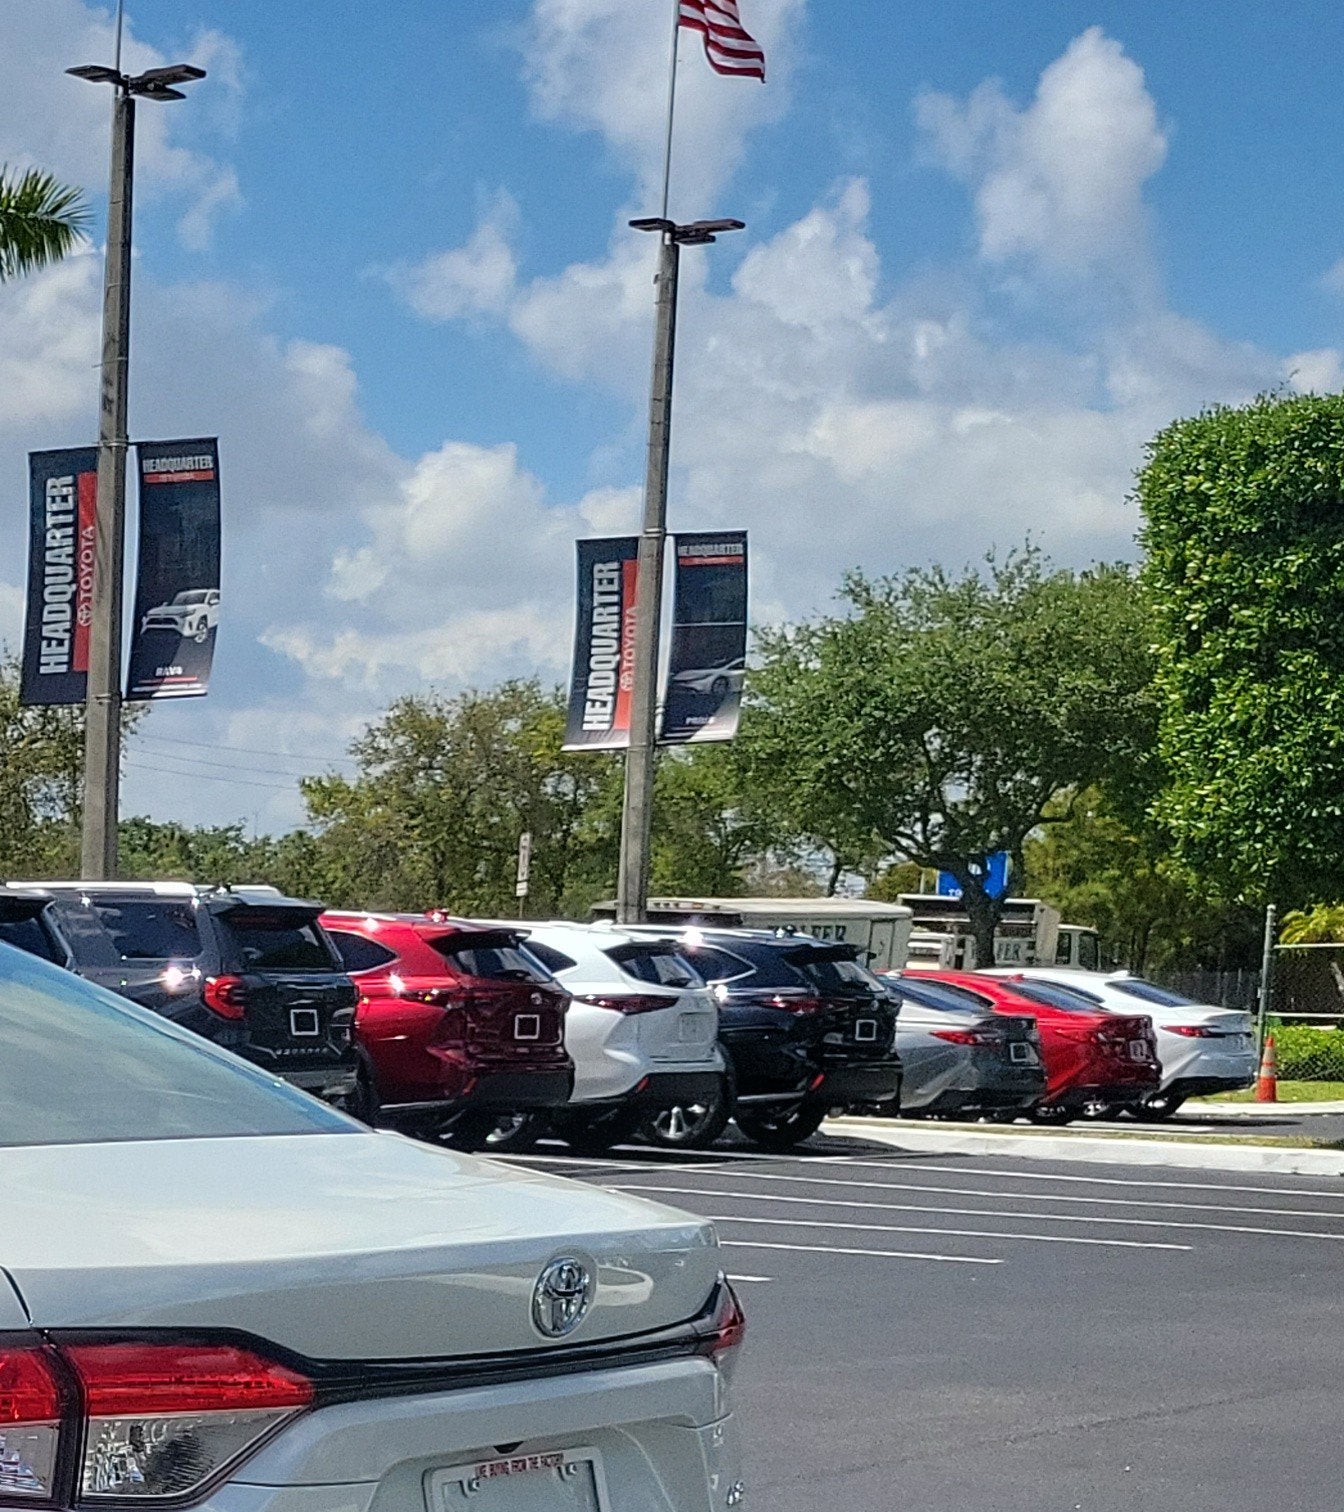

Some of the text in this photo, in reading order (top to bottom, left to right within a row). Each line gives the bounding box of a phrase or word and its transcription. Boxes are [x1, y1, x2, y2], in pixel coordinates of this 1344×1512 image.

[40, 475, 76, 674] HEADQUARTER
[80, 526, 97, 600] TOYOTA
[583, 561, 623, 731] HEADQUARTER
